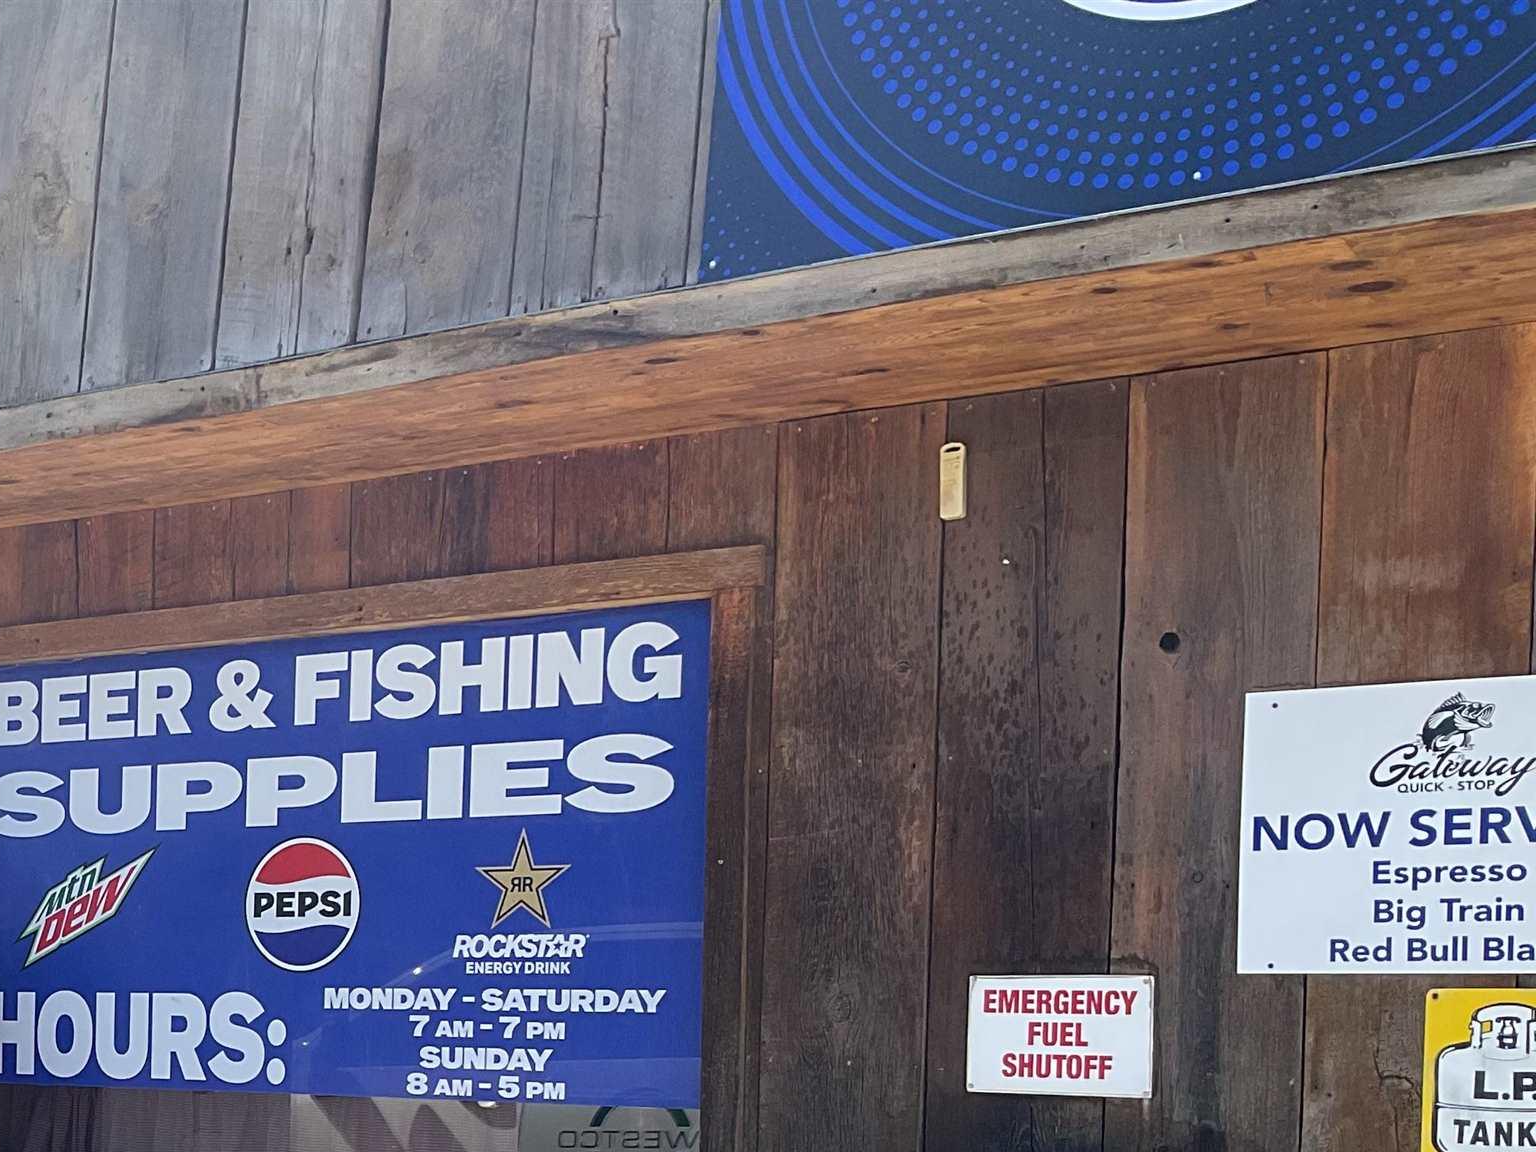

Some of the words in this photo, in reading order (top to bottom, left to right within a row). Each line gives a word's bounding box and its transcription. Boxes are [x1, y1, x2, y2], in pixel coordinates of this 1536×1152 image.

[208, 659, 274, 733] &
[294, 622, 682, 726] FISHING
[1369, 743, 1536, 797] Gateway
[1397, 782, 1444, 793] QUICK
[1457, 780, 1495, 791] STOP
[1252, 811, 1392, 851] NOW
[1372, 860, 1527, 891] Espresso
[253, 889, 352, 918] PEPSI
[1373, 899, 1427, 930] Big
[1439, 896, 1524, 922] Train
[453, 934, 586, 958] ROCKSTAR
[1329, 936, 1392, 962] Red
[1407, 936, 1468, 962] Bull
[1483, 935, 1536, 962] Bla
[466, 962, 524, 974] ENERGY
[525, 962, 570, 974] DRINK
[324, 987, 457, 1010] MONDAY
[481, 988, 666, 1013] SATURDAY
[983, 989, 1138, 1015] EMERGENCY
[409, 1015, 430, 1038] 7
[435, 1020, 473, 1038] AM
[498, 1016, 521, 1039] 7
[526, 1021, 565, 1040] PM
[1027, 1021, 1088, 1047] FUEL
[419, 1046, 554, 1072] SUNDAY
[1001, 1052, 1113, 1080] SHUTOFF
[406, 1073, 428, 1096] 8
[434, 1079, 472, 1097] AM
[498, 1076, 520, 1099] 5
[526, 1081, 565, 1100] PM
